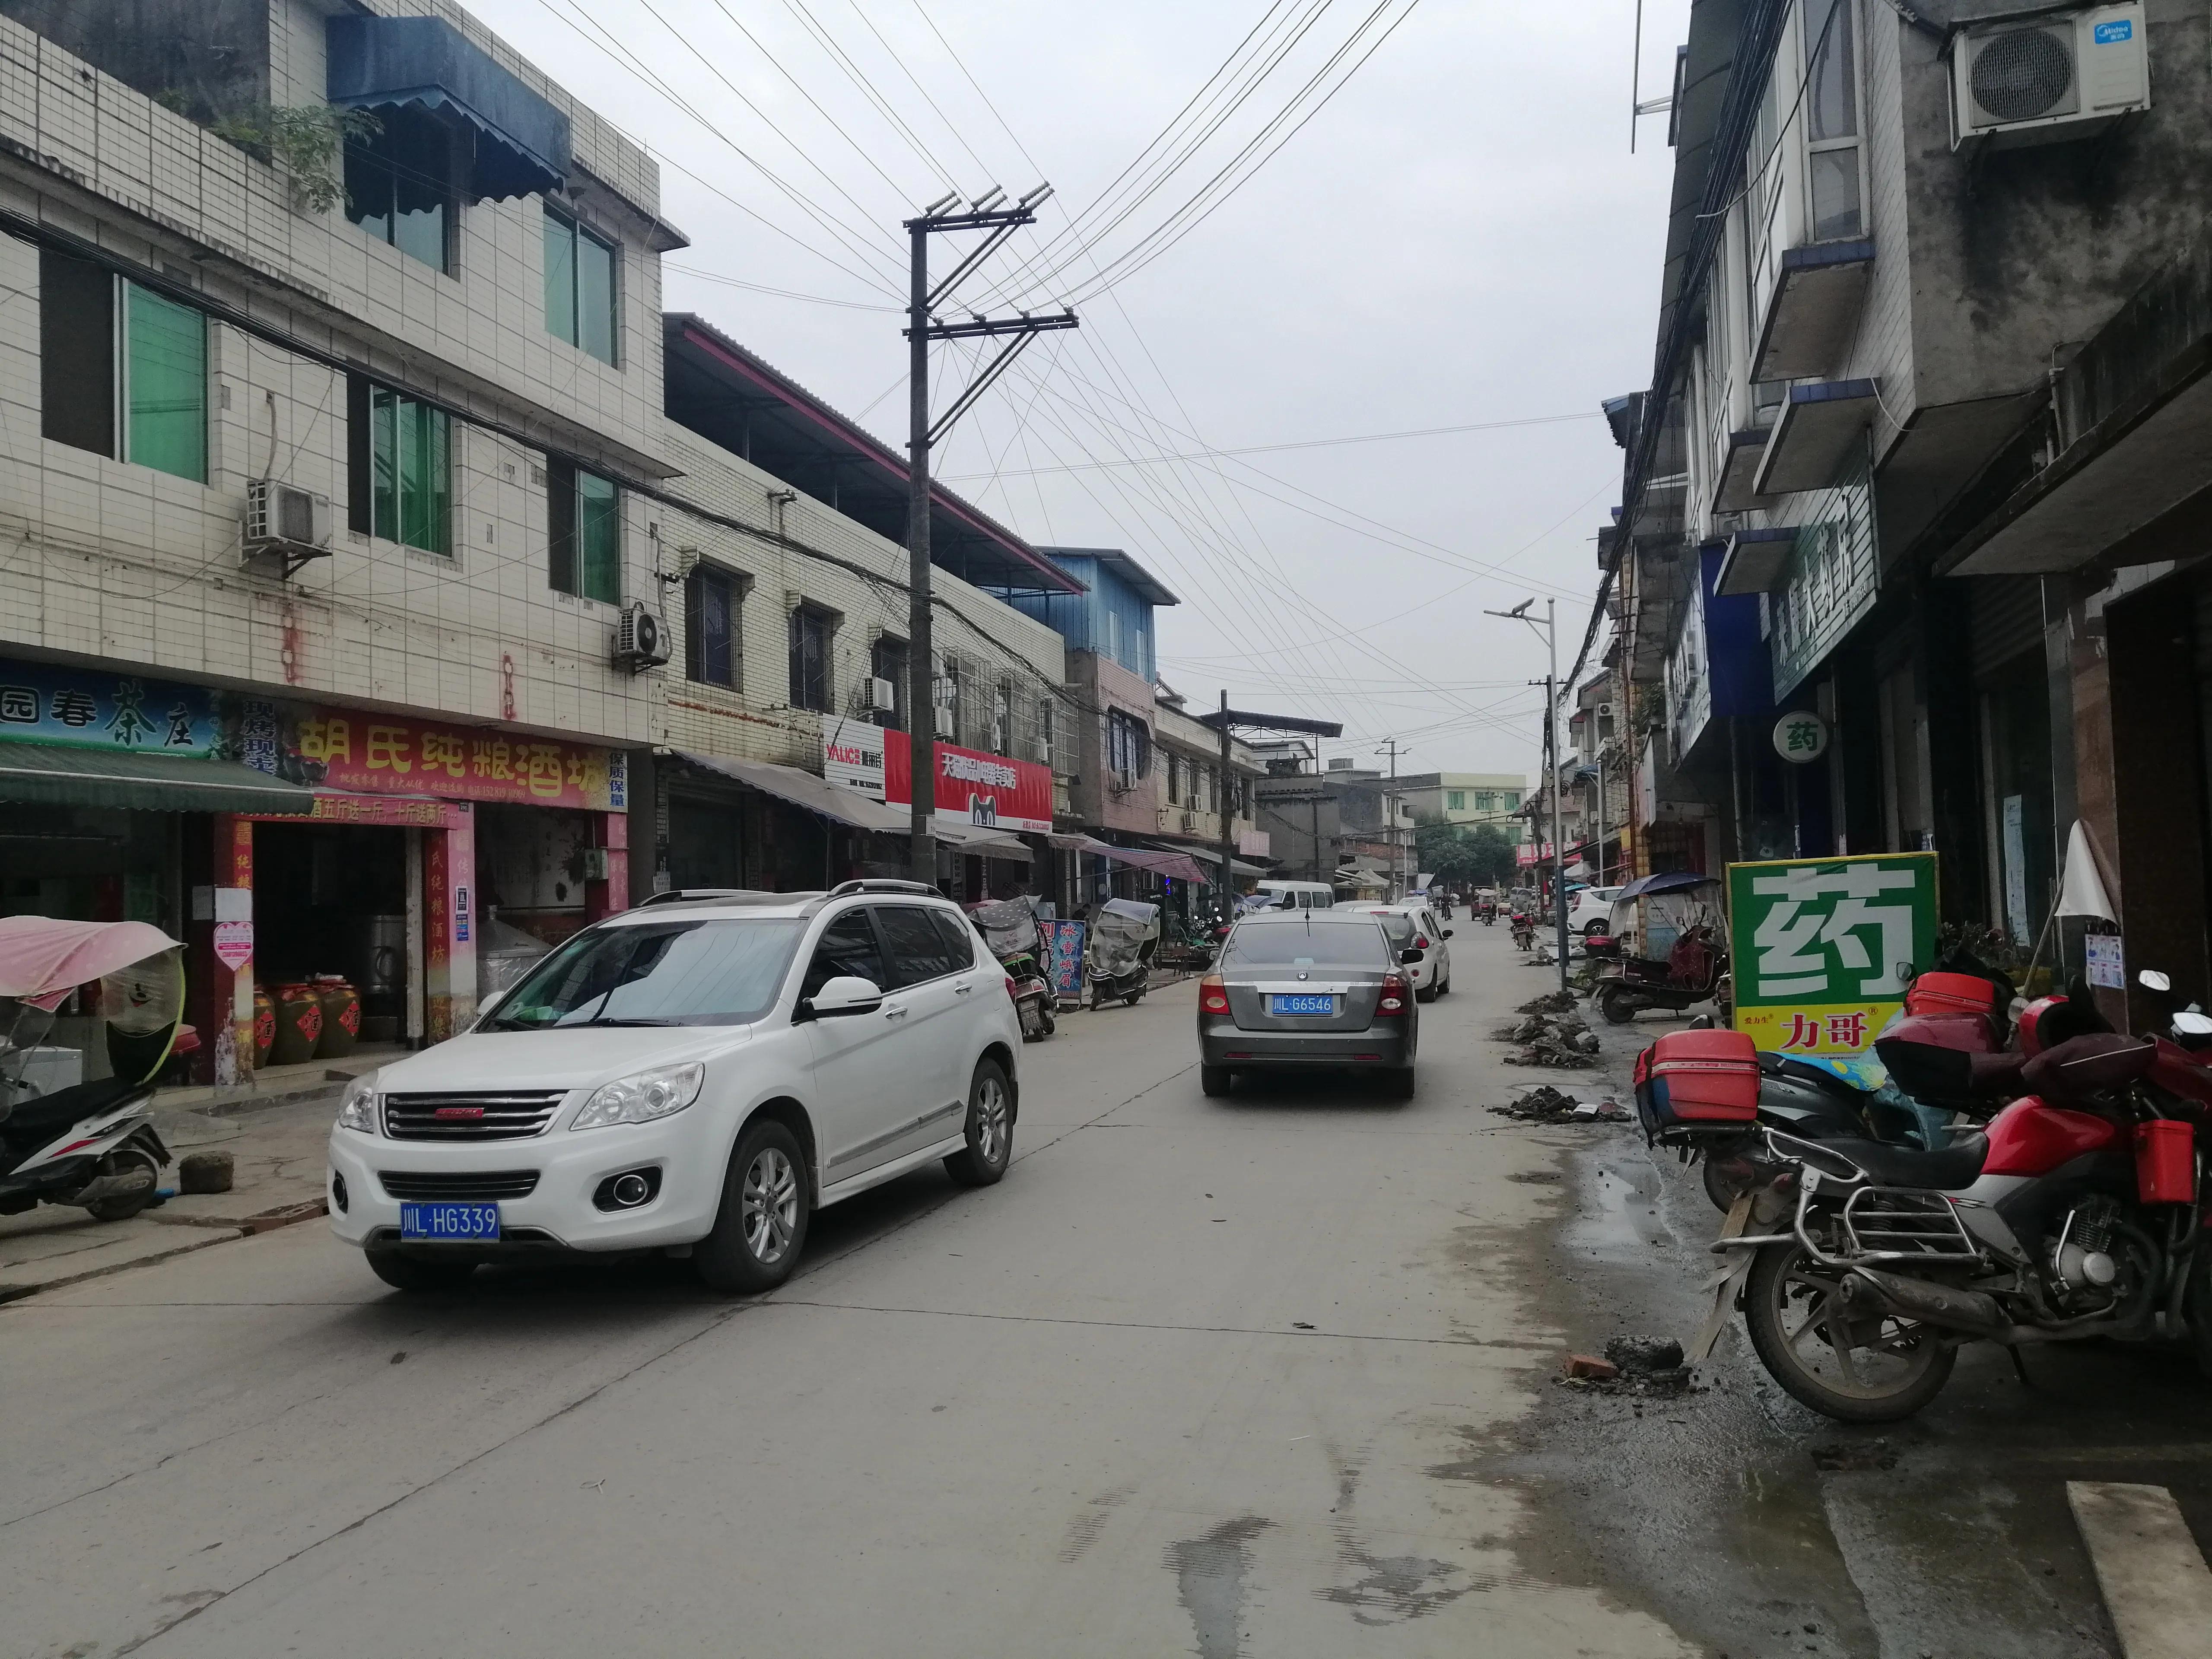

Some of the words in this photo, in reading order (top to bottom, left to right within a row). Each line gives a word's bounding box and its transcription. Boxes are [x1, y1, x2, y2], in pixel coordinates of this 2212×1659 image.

[1, 679, 193, 747] 园春茶庄
[1786, 722, 1818, 751] 药
[609, 753, 624, 806] 保质保量
[826, 744, 860, 765] YALICE
[1058, 924, 1077, 988] 冰雪峨眉
[1753, 863, 1915, 996] 药
[1744, 1016, 1769, 1025] 爱力生
[1780, 1012, 1868, 1049] 力哥
